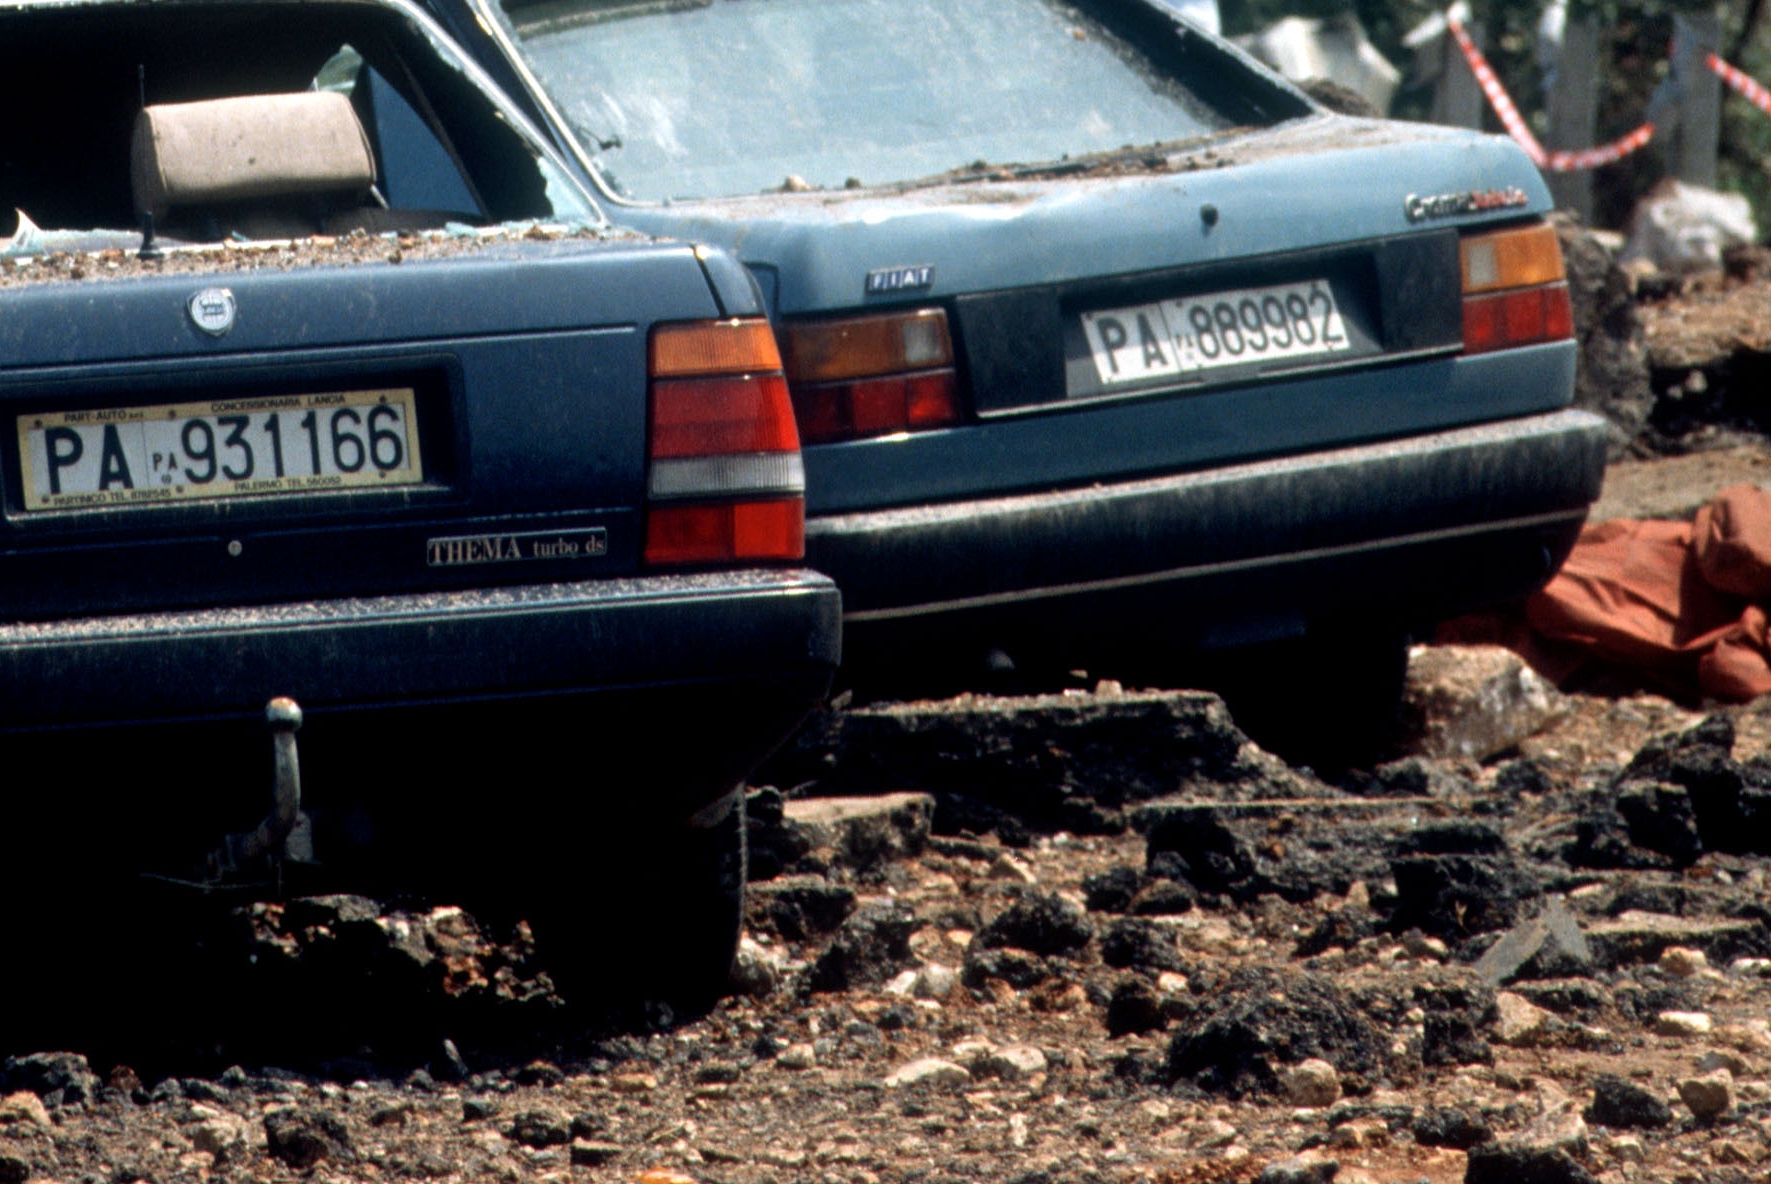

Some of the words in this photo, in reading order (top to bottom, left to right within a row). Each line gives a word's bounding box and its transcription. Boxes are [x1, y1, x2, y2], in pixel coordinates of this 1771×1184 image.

[871, 267, 930, 290] FIAT
[1096, 313, 1168, 374] PA
[1189, 288, 1344, 359] 889982
[211, 397, 301, 412] CONCESSIONARIA
[307, 394, 346, 406] LANCIA
[43, 423, 134, 496] PA
[181, 407, 404, 484] 931166
[152, 452, 179, 473] PA
[234, 479, 283, 491] PALERMO
[428, 536, 523, 565] THEMA
[532, 537, 579, 557] turbo
[584, 534, 606, 554] ds
